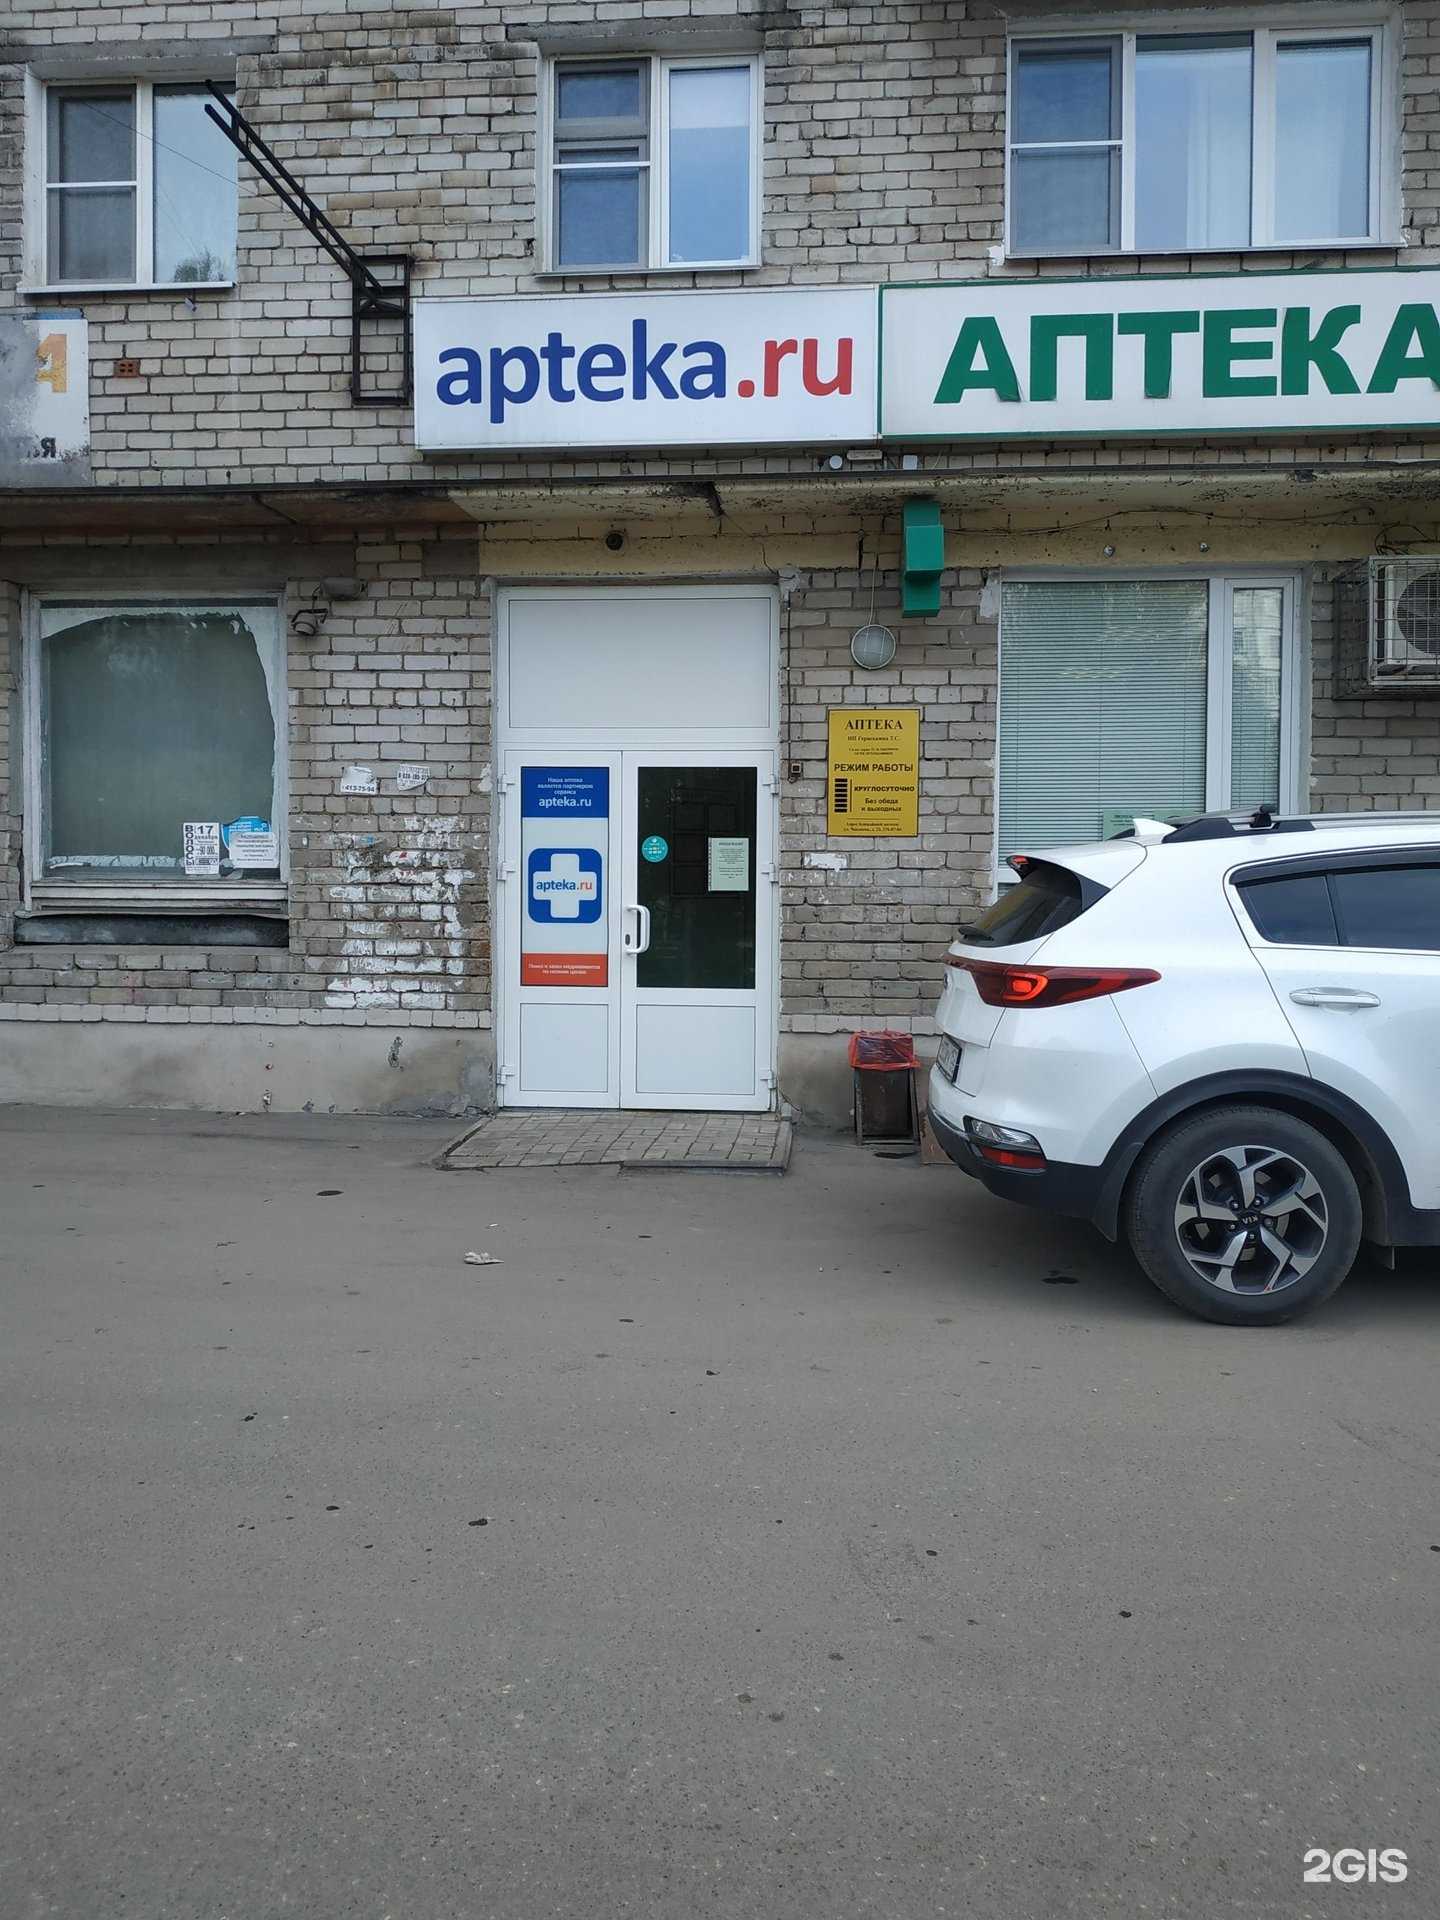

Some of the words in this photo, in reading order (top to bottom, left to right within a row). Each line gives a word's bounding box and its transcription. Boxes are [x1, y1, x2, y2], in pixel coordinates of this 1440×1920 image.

[932, 303, 1440, 404] АПТЕКА
[435, 318, 854, 425] apteka.ru
[845, 719, 903, 730] АПТЕКА
[834, 763, 869, 772] РЕЖИМ
[872, 763, 914, 772] РАБОТЫ
[538, 796, 592, 809] apteka.ru
[197, 825, 214, 835] 17
[536, 879, 593, 892] apteka.ru
